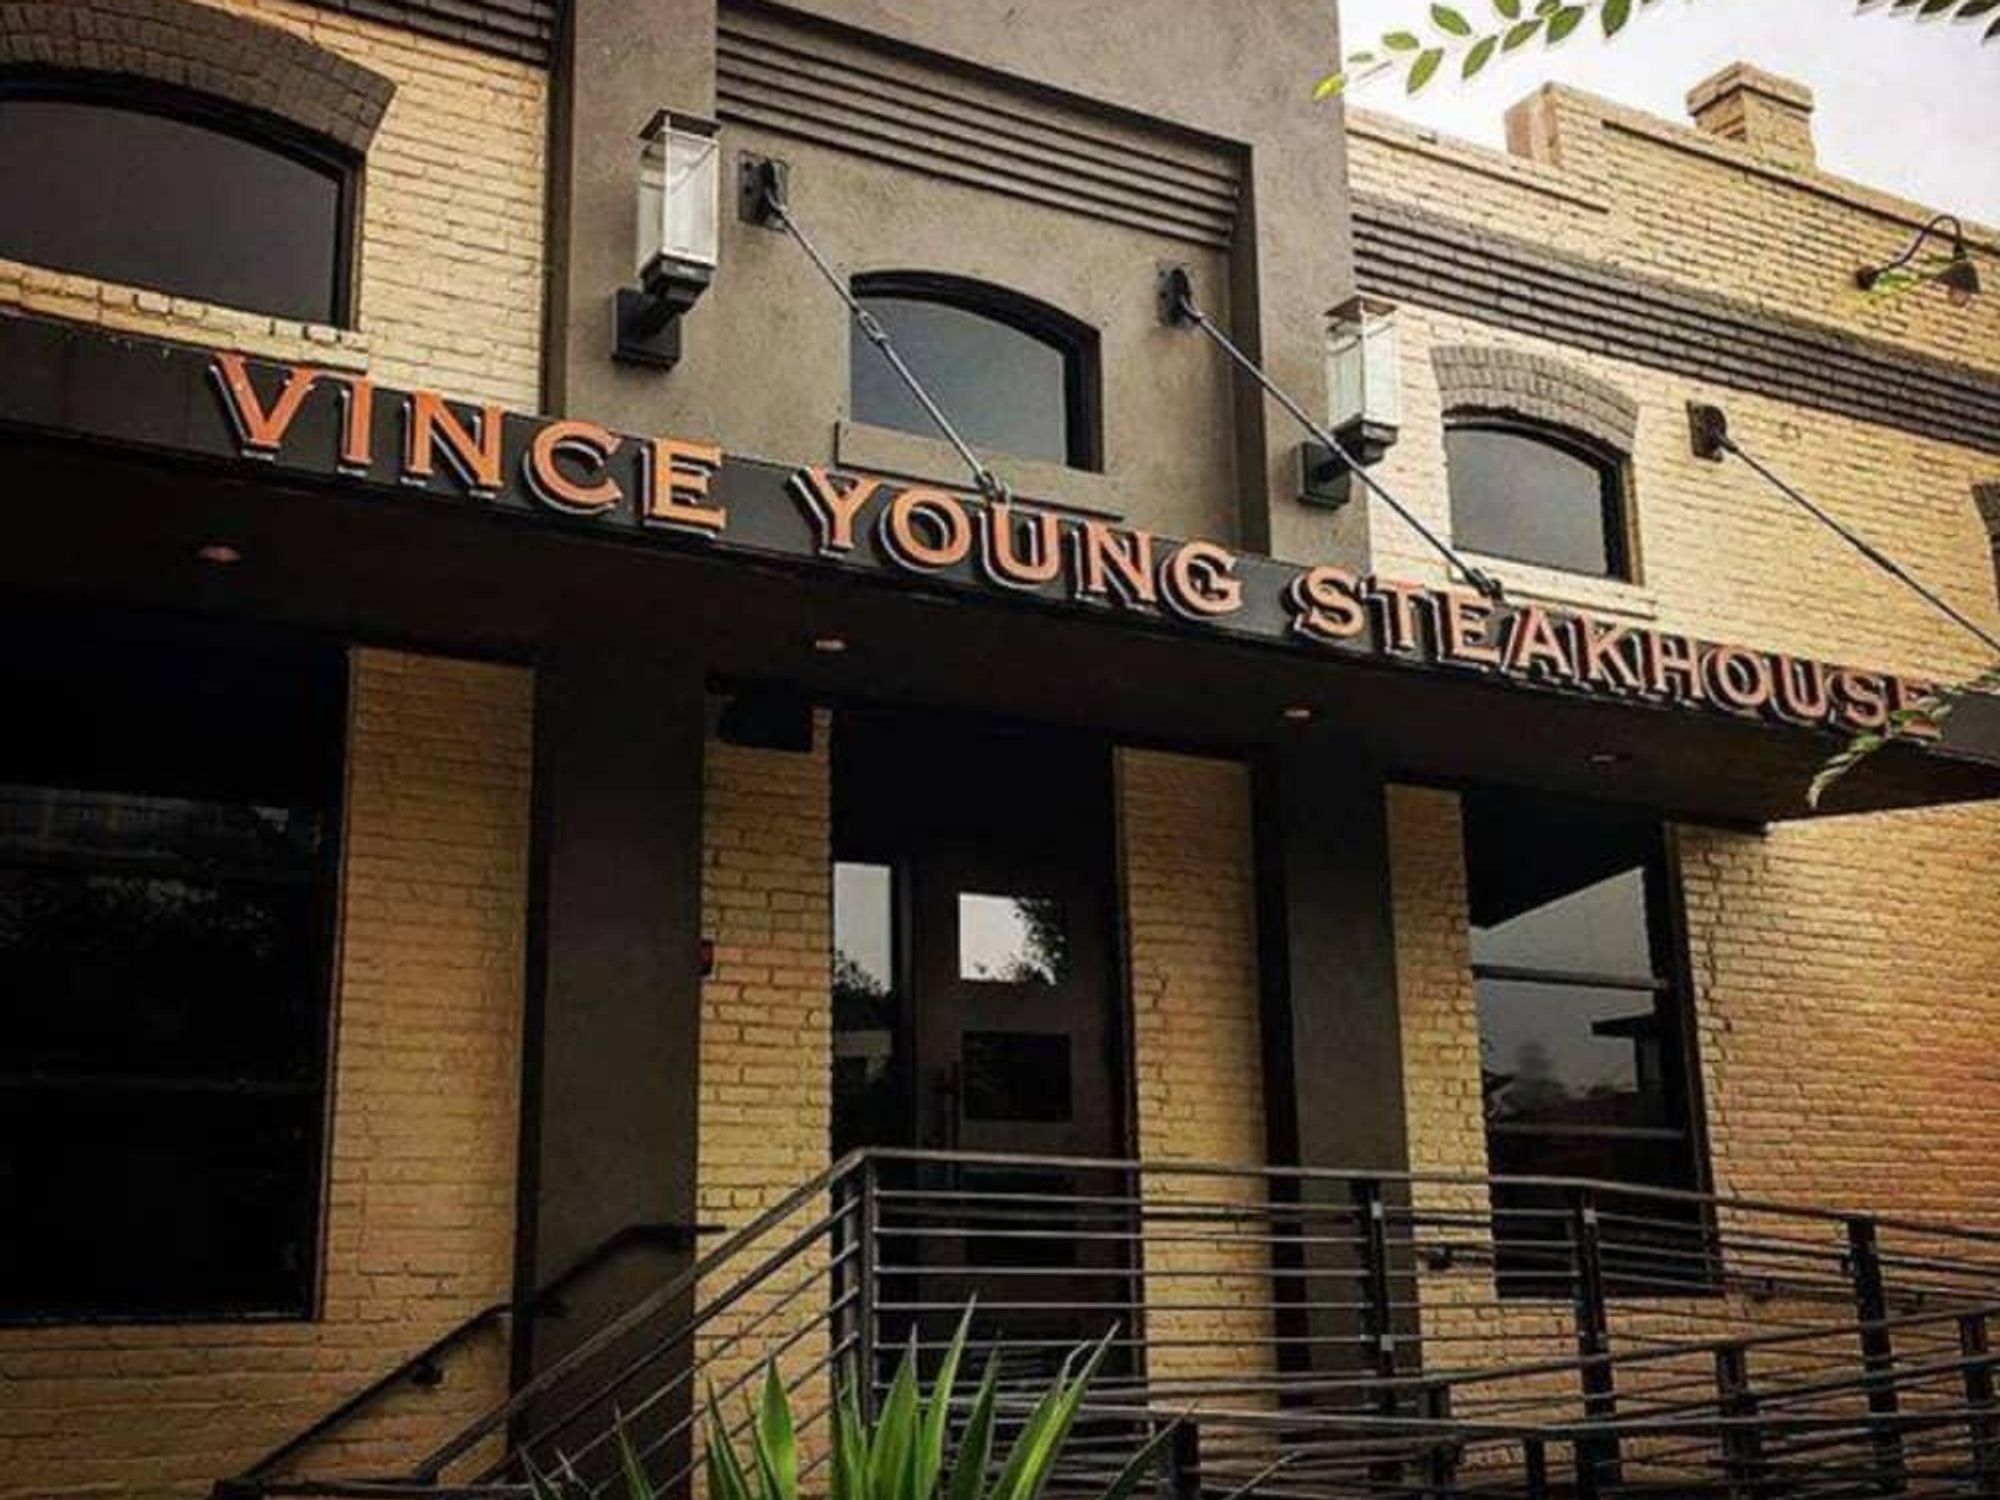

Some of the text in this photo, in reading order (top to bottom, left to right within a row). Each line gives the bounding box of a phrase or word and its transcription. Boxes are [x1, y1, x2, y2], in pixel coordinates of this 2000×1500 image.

[211, 351, 1942, 744] VINCE YOUNG STEAKHOUSE
